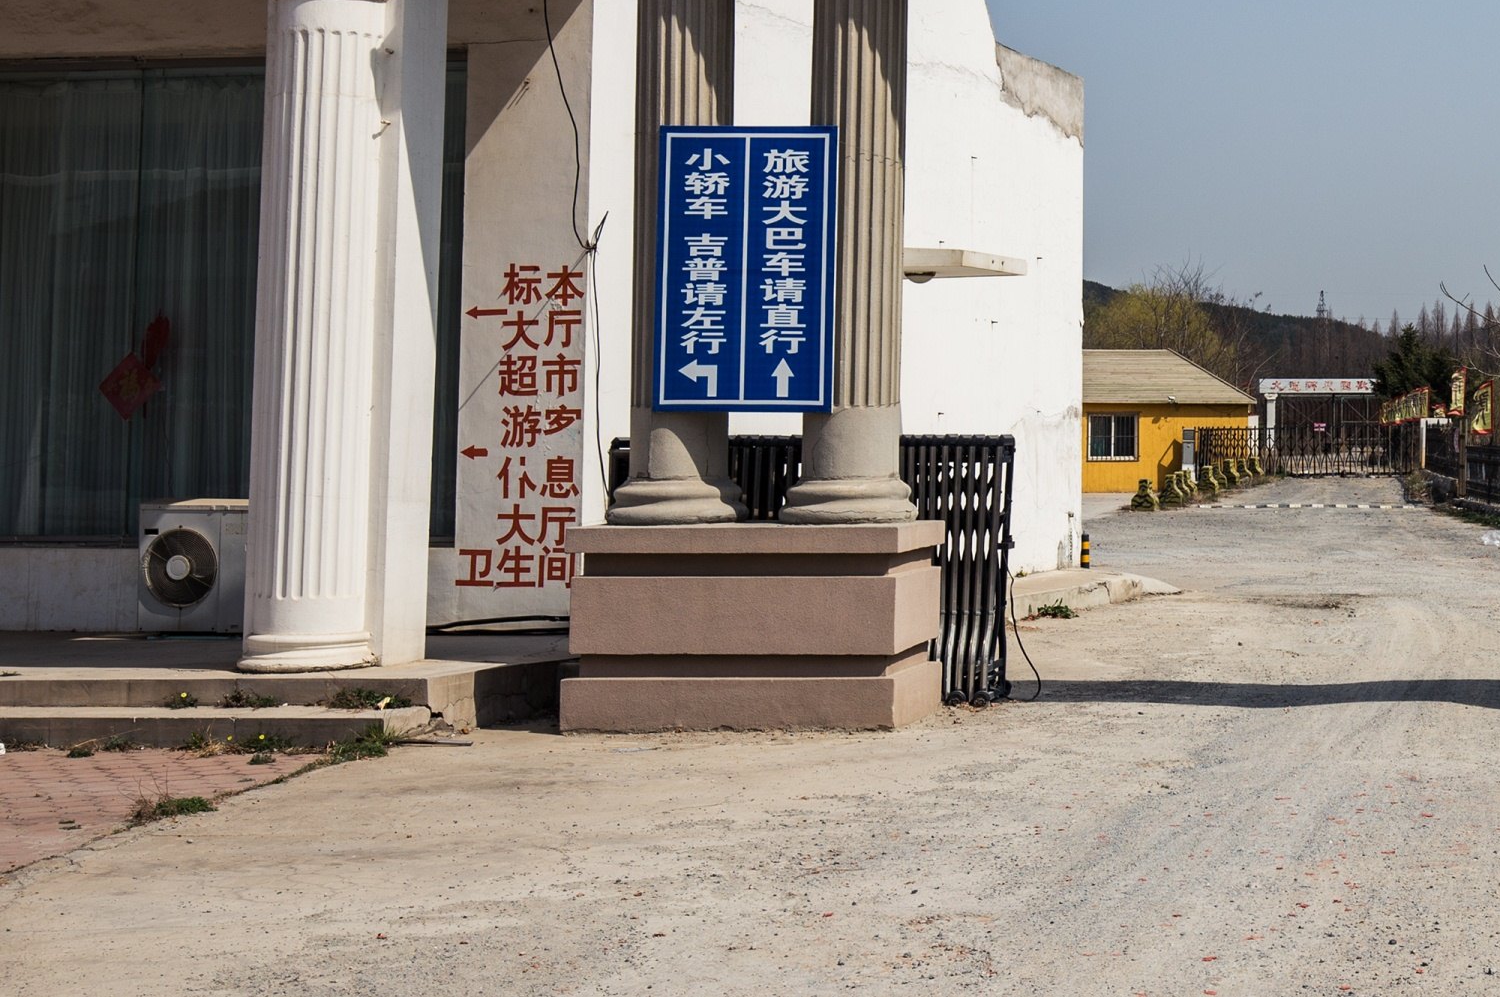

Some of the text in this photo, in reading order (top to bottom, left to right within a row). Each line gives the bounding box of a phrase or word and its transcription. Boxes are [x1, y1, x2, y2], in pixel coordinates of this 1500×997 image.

[680, 148, 730, 355] 小轿车 吉普请左行
[759, 148, 809, 354] 旅游大巴车请直行
[503, 263, 585, 306] 标本
[501, 309, 582, 350] 大厅
[498, 354, 581, 397] 超市
[496, 503, 576, 547] 大厅
[455, 545, 576, 589] 卫生间
